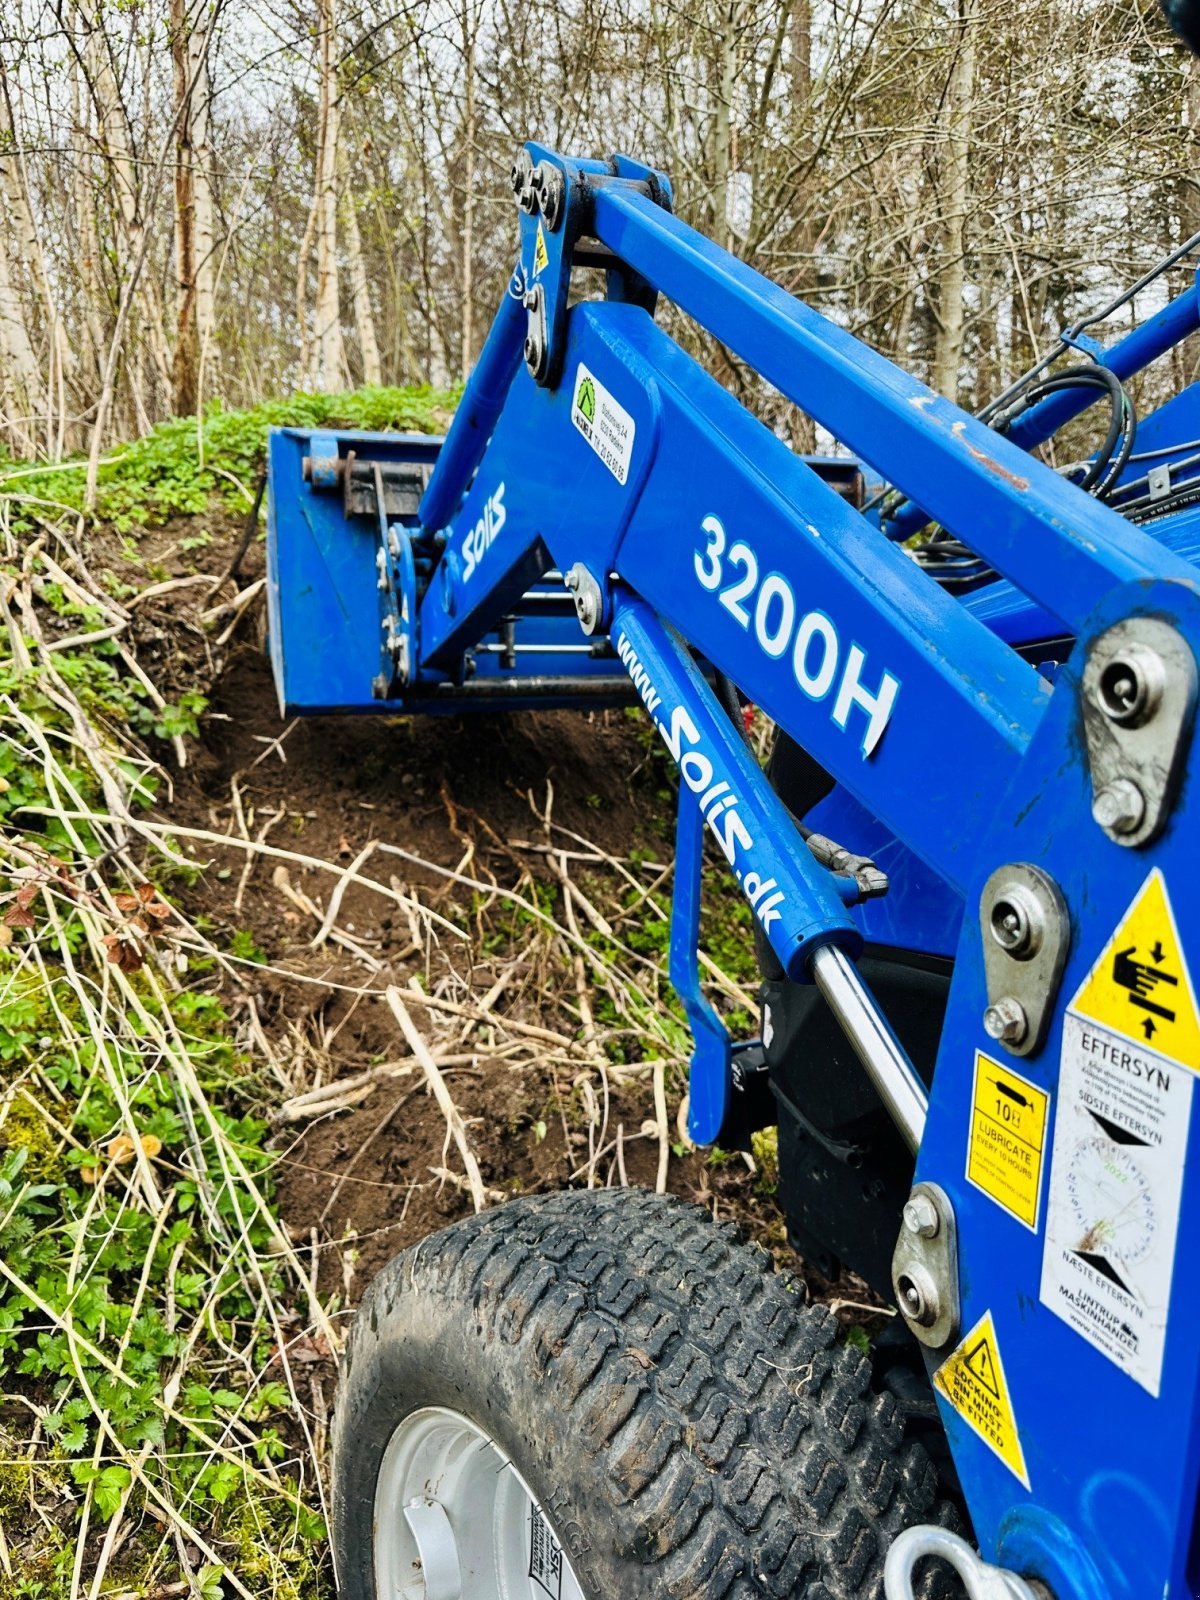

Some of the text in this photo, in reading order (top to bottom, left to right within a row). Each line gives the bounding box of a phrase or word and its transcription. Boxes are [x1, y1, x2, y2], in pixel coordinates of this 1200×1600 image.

[694, 512, 901, 760] 3200H
[1081, 1032, 1170, 1092] EFTERSYN
[994, 1097, 1010, 1122] 10
[1078, 1089, 1162, 1146] SIDSTE EFTERSYN
[976, 1133, 1031, 1180] EVERY 10 HOURS
[978, 1119, 1031, 1166] LUBRICATE
[1062, 1249, 1143, 1319] NÆSTE EFTERSYN
[1077, 1287, 1120, 1328] LINTRUP
[1059, 1282, 1139, 1355] MASKINHANDEL
[952, 1387, 1004, 1448] BE FITTED
[953, 1377, 1002, 1432] PIN MUST
[954, 1363, 1000, 1417] LOCKING
